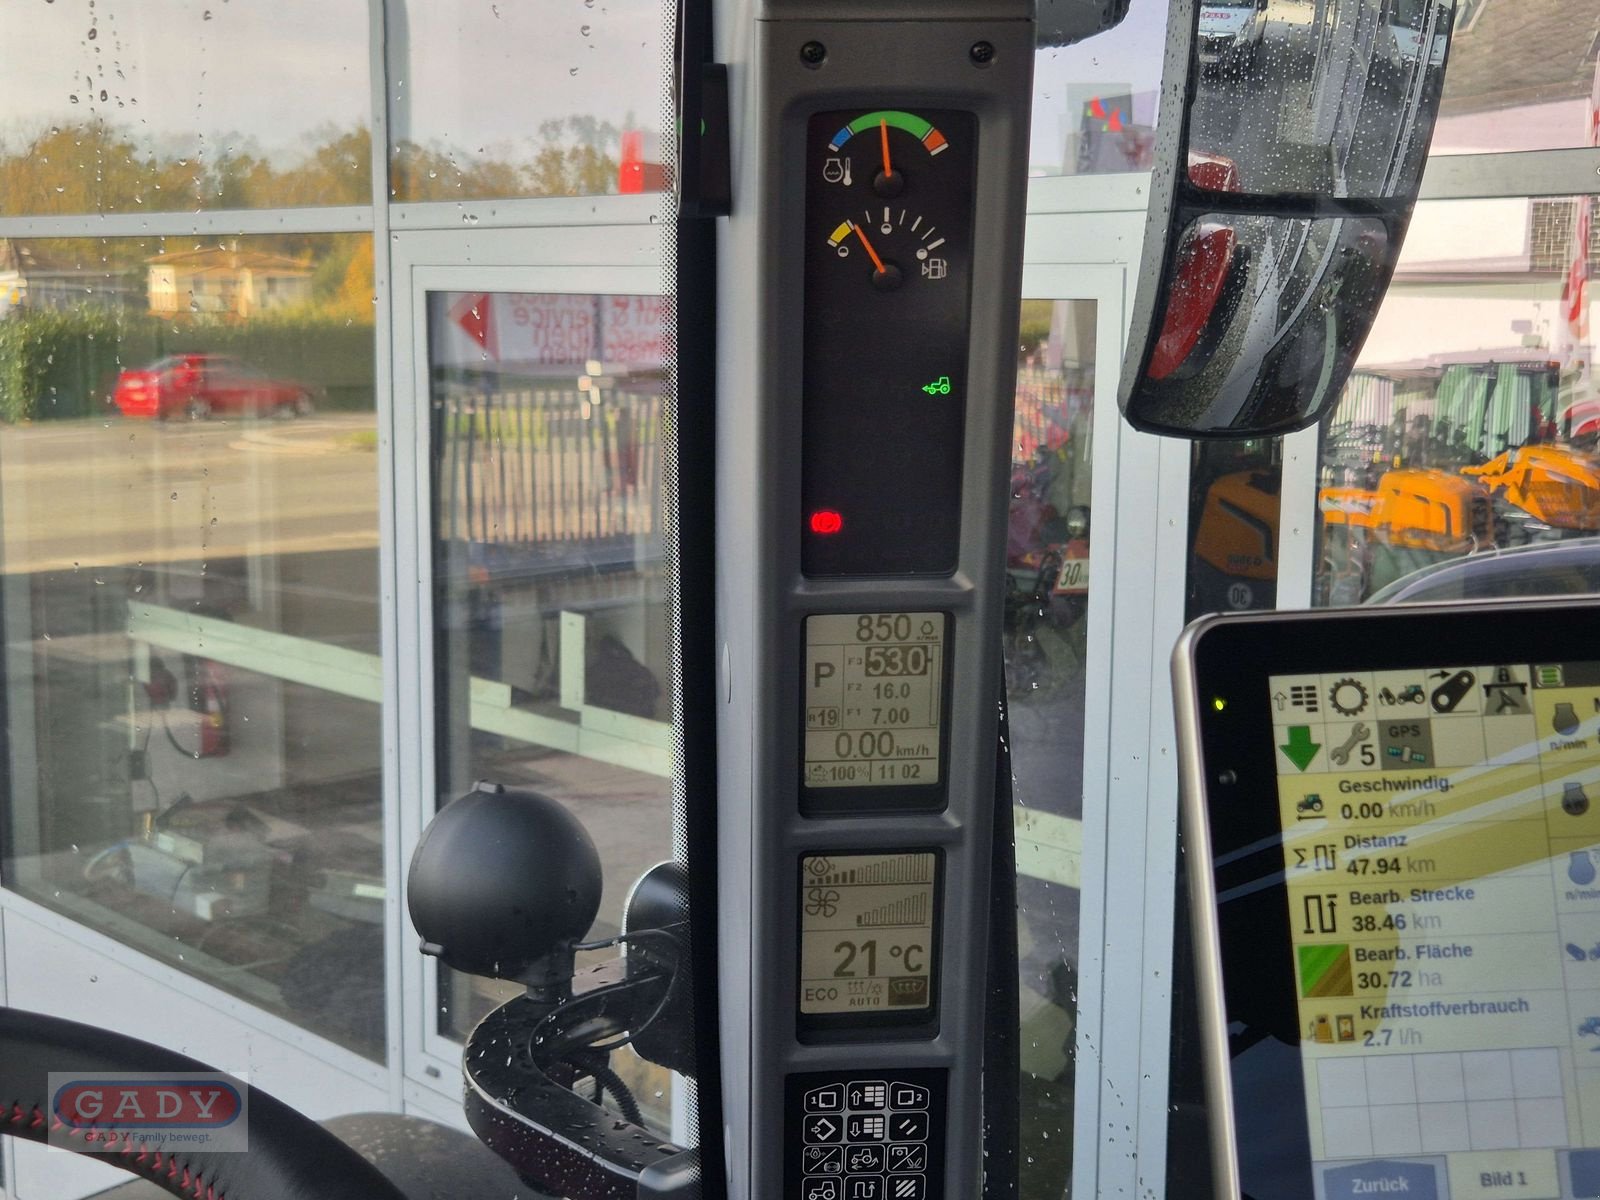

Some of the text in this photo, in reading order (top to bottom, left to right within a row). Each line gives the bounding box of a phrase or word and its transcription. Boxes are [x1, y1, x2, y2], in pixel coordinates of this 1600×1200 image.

[856, 614, 912, 642] 850
[868, 647, 926, 675] 53.0
[814, 662, 836, 688] P
[847, 682, 911, 700] F2 16.0
[847, 707, 910, 725] F1 7.00
[1388, 724, 1421, 739] GPS
[835, 731, 929, 758] 0.00 km/h
[1360, 744, 1375, 766] 5
[1338, 776, 1455, 794] Geschwindig.
[1341, 801, 1436, 820] 0.00 km/h
[1343, 834, 1407, 850] Distanz
[1346, 856, 1437, 876] 47.94 km
[1349, 886, 1475, 906] Bearb. Strecke
[1351, 912, 1442, 932] 38.46 km
[833, 940, 877, 977] 21
[1354, 943, 1473, 962] Bearb. Fläche
[1357, 969, 1442, 989] 30.72 ha
[805, 987, 838, 1001] ECO
[849, 996, 880, 1006] AUTO
[1360, 997, 1530, 1020] Kraftstoffverbrauch
[1363, 1029, 1392, 1047] 2.7
[1351, 1176, 1409, 1194] Zurück
[1481, 1171, 1528, 1187] Bild 1
